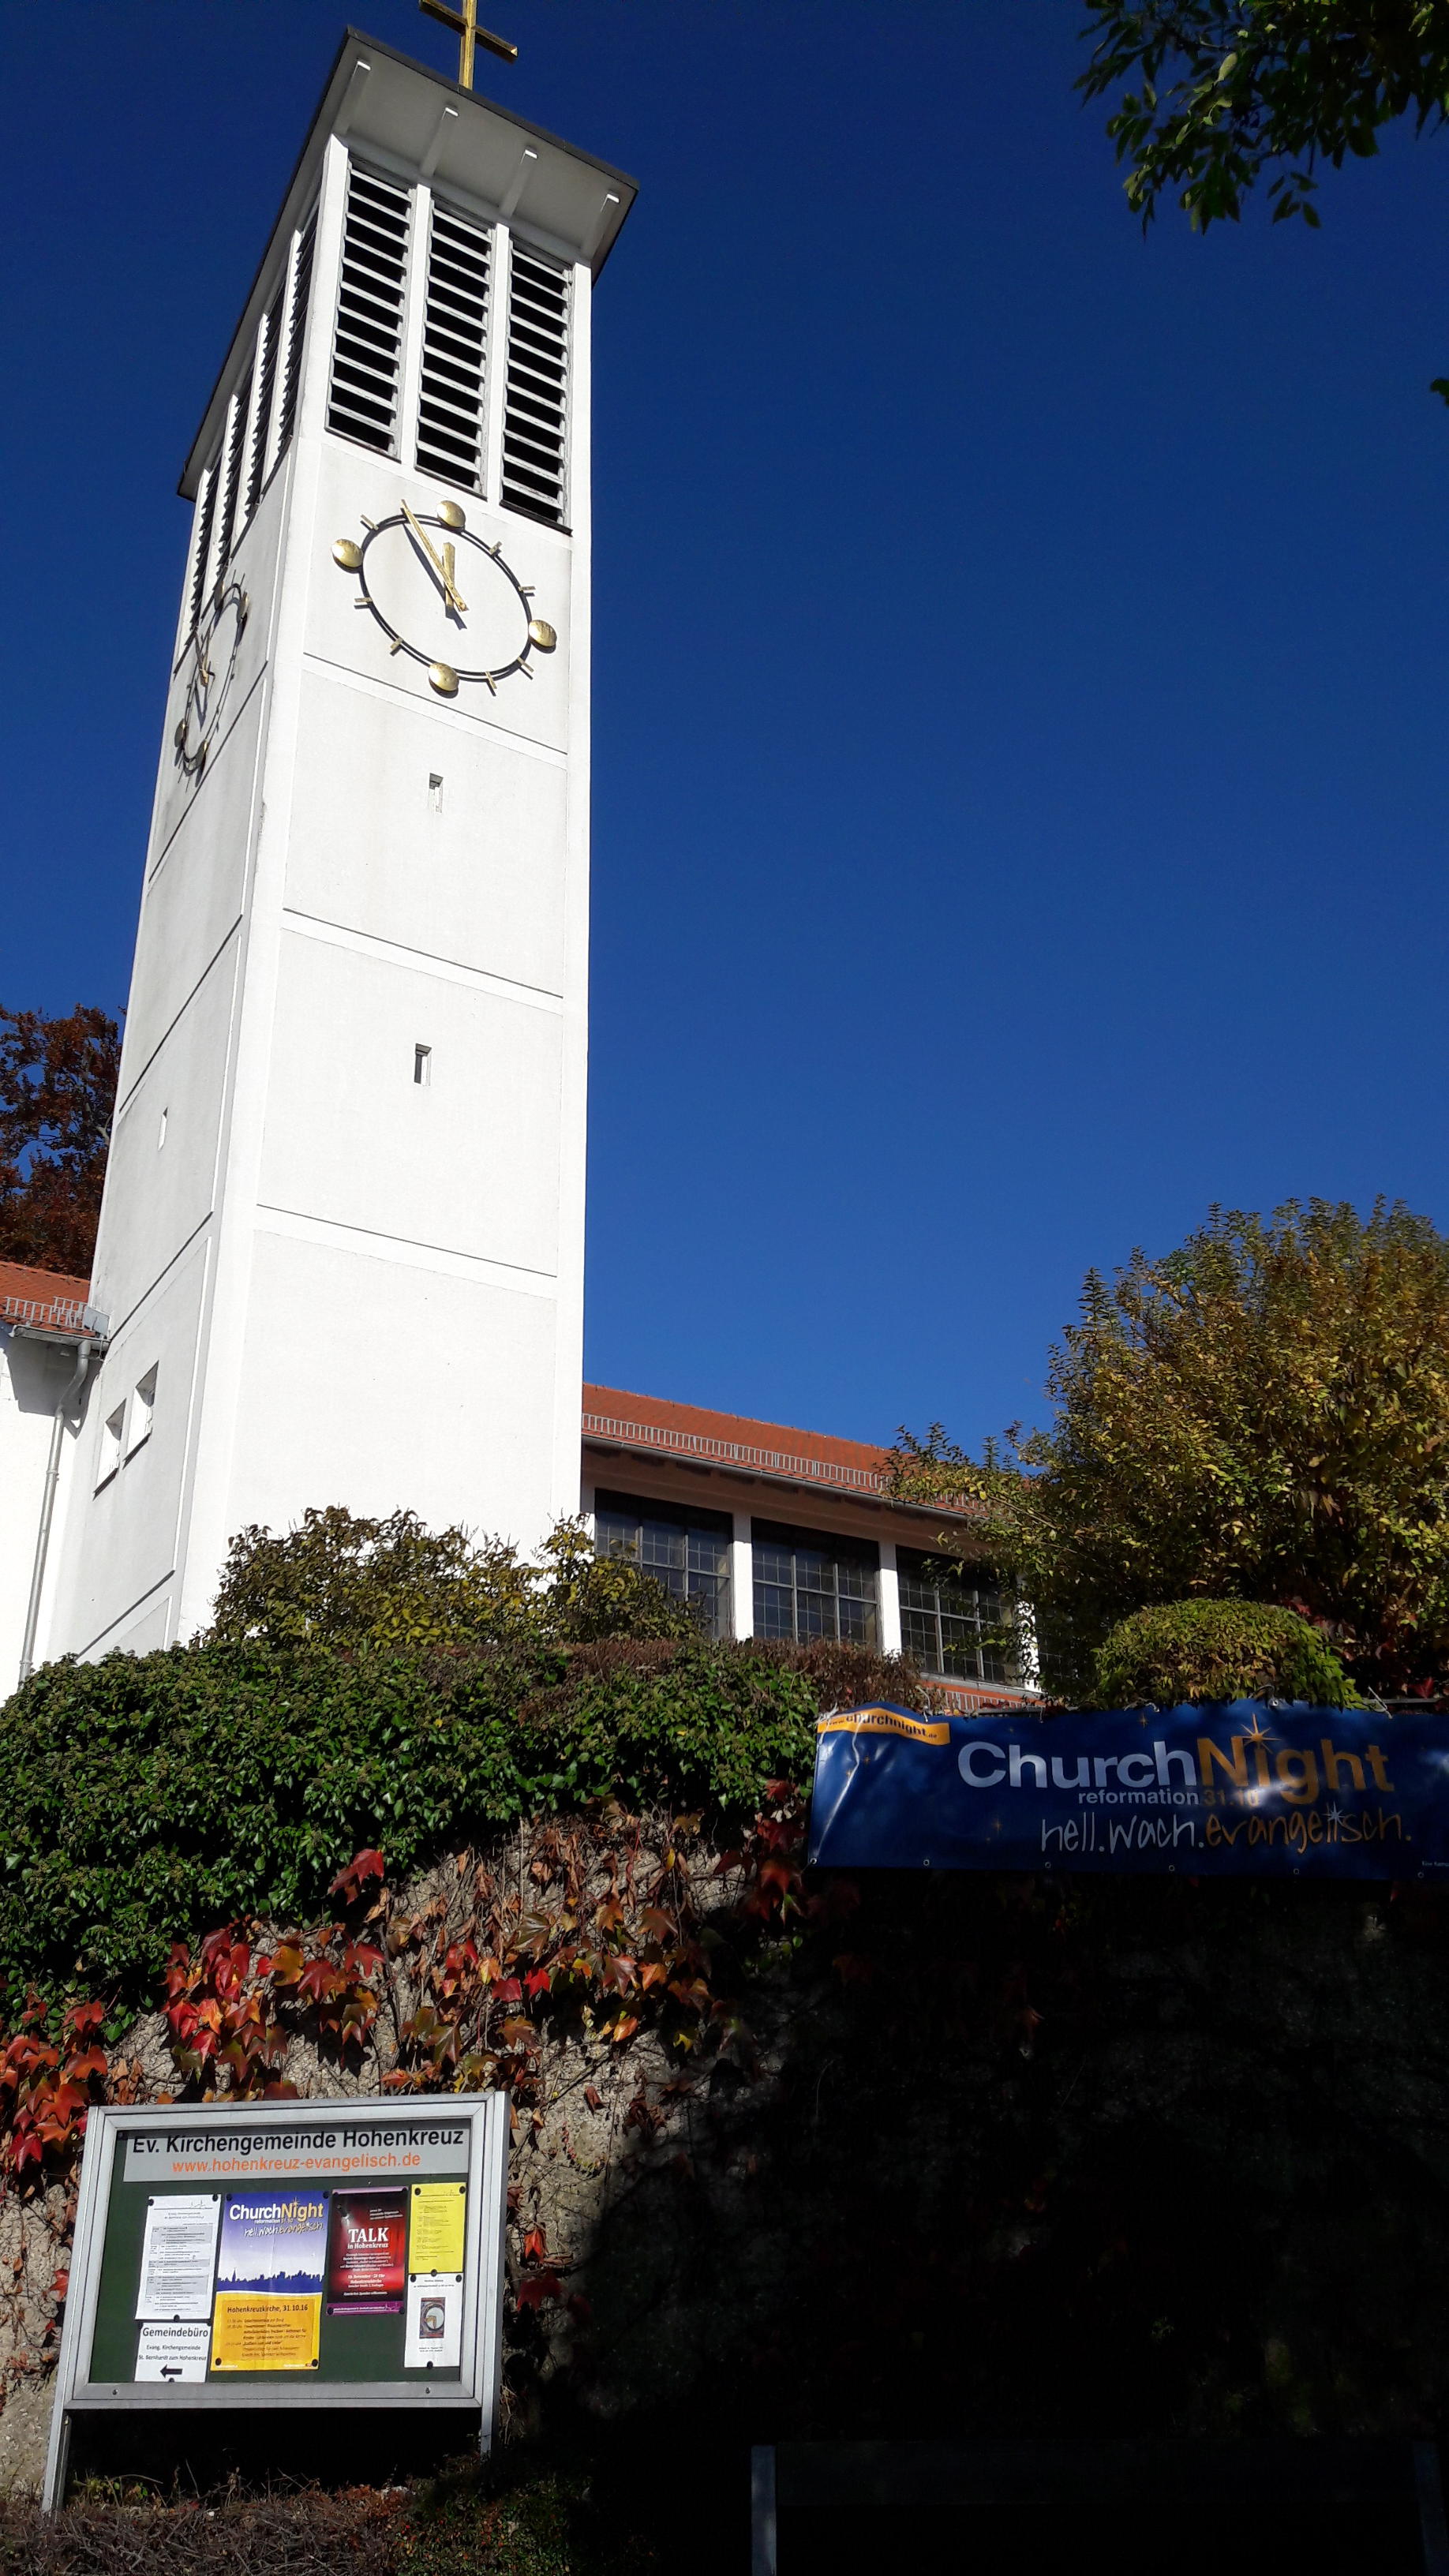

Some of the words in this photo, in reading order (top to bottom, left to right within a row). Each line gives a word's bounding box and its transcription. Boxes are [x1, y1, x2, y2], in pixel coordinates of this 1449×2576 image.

[957, 1733, 1395, 1805] ChurchNight
[1078, 1788, 1200, 1805] reformation
[133, 2136, 160, 2154] Ev.
[166, 2131, 336, 2156] Kirchengemeinde
[343, 2128, 464, 2148] Hohenkreuz
[171, 2151, 421, 2174] www.hohenkreuz-evangelisch.de
[229, 2202, 324, 2222] ChurchNight
[348, 2227, 390, 2243] TALK
[142, 2327, 208, 2337] Gemeindebüro
